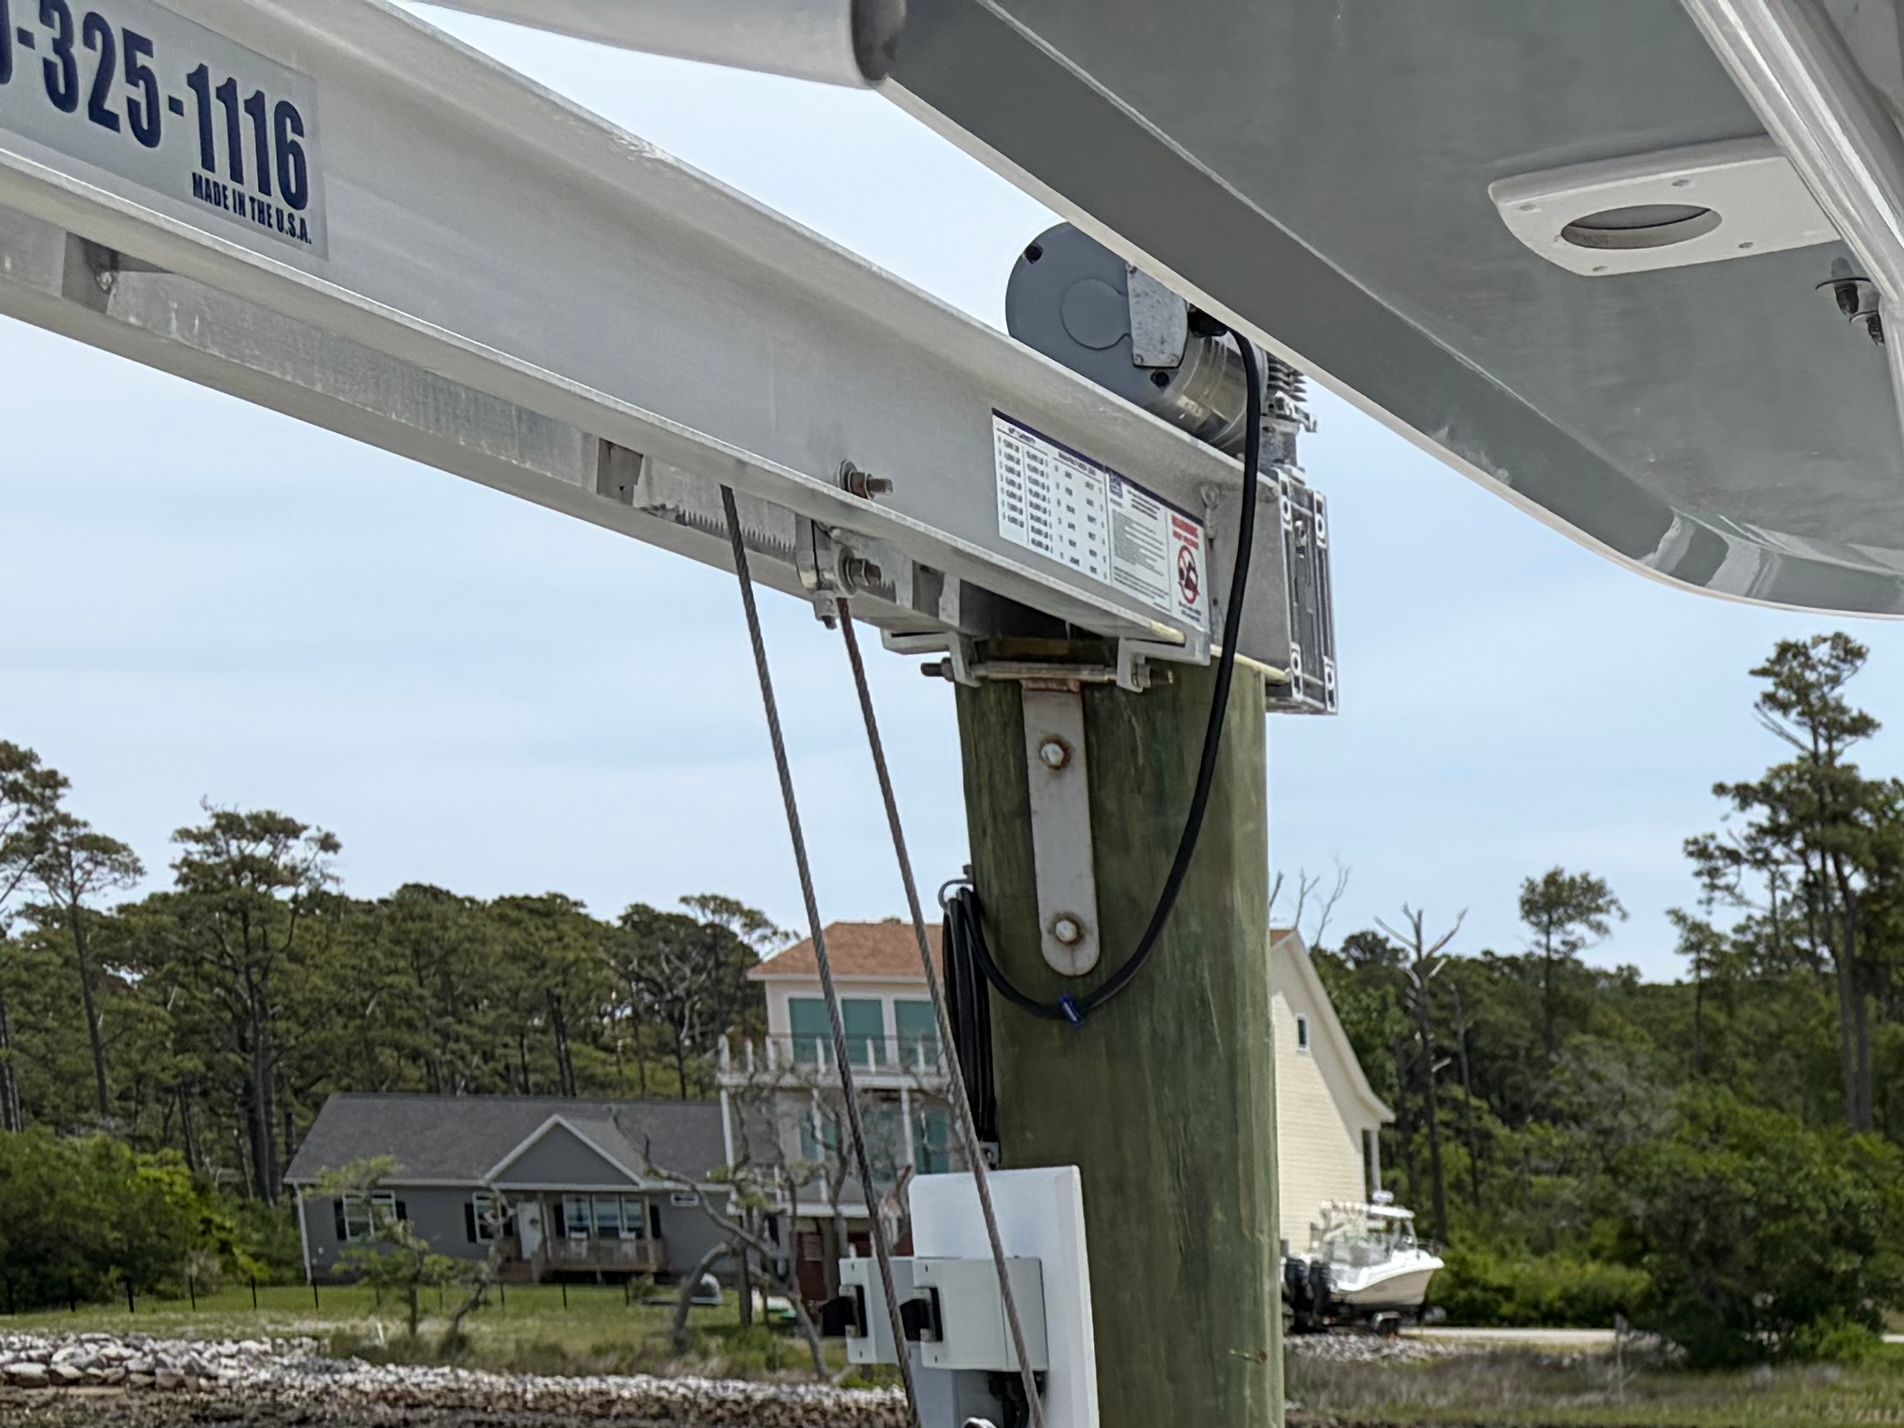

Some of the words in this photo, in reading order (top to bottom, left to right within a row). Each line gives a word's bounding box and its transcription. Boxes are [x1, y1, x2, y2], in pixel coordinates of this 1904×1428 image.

[192, 172, 229, 211] MADE
[232, 188, 246, 218] IN
[248, 196, 273, 229] THE
[275, 208, 312, 244] U.S.A.
